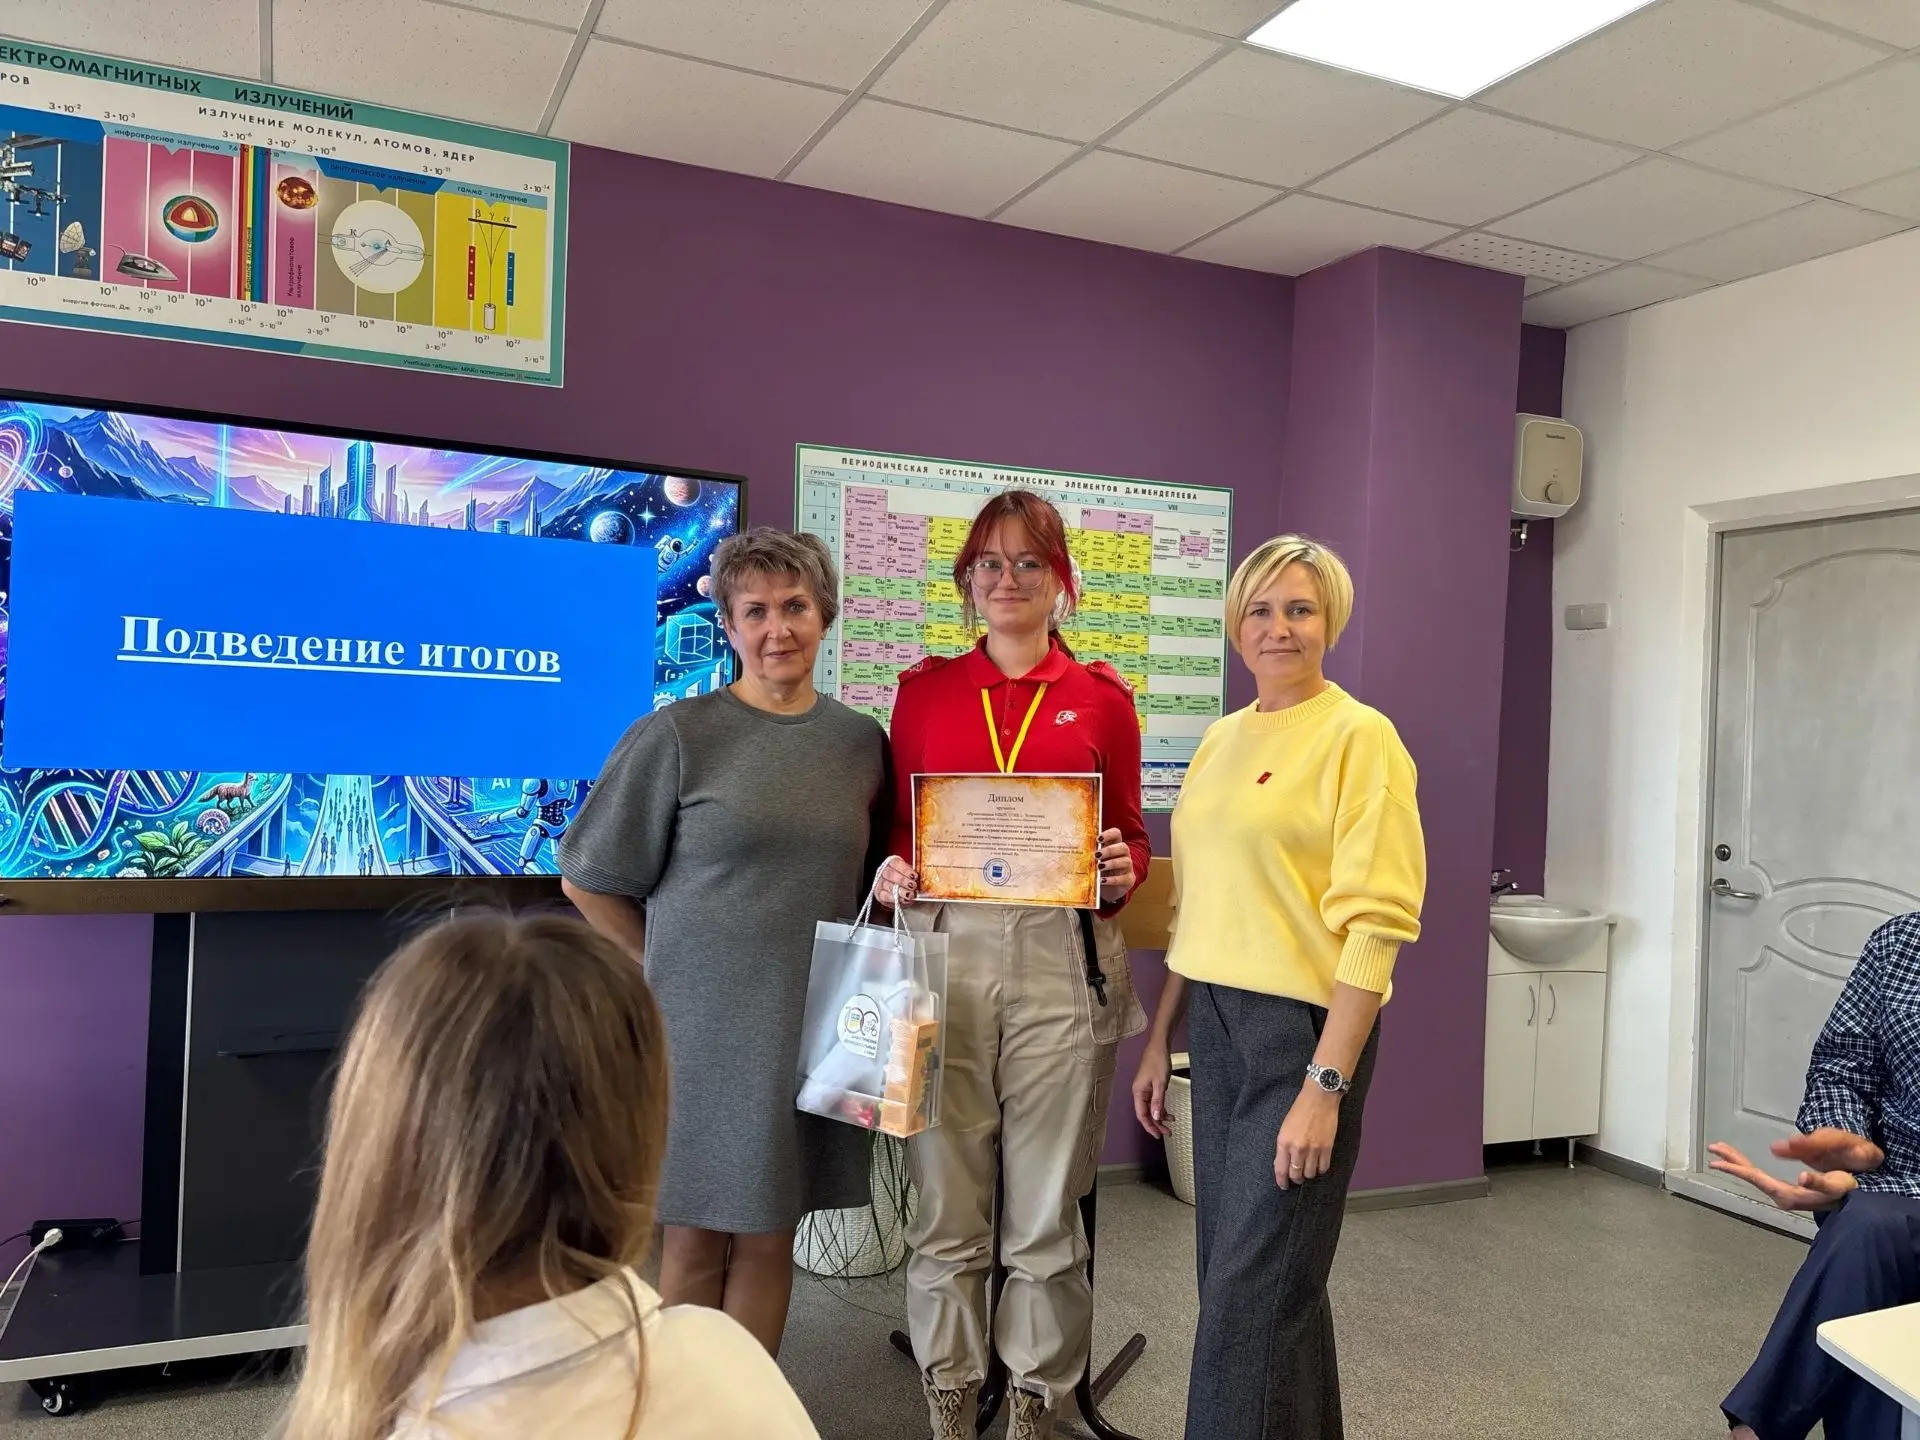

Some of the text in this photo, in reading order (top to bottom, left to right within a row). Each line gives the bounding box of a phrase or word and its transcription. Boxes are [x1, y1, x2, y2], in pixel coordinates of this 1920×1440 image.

[0, 46, 354, 120] ЕКТРОМАГНИТНЫХ ИЗЛУЧЕНИЙ
[1, 73, 29, 84] РОВ
[199, 107, 476, 163] ИЗЛУЧЕНИЕ МОЛЕКУЛ, АТОМОВ, ЯДЕР
[810, 469, 835, 477] ГРУППЫ
[842, 457, 929, 473] ПЕРИОДИЧЕСКАЯ
[939, 467, 984, 479] СИСТЕМА
[993, 473, 1056, 487] ХИМИЧЕСКИХ
[1065, 480, 1118, 493] ЭЛЕМЕНТОВ
[120, 615, 561, 674] Подведение итогов
[987, 793, 1024, 803] Диплом
